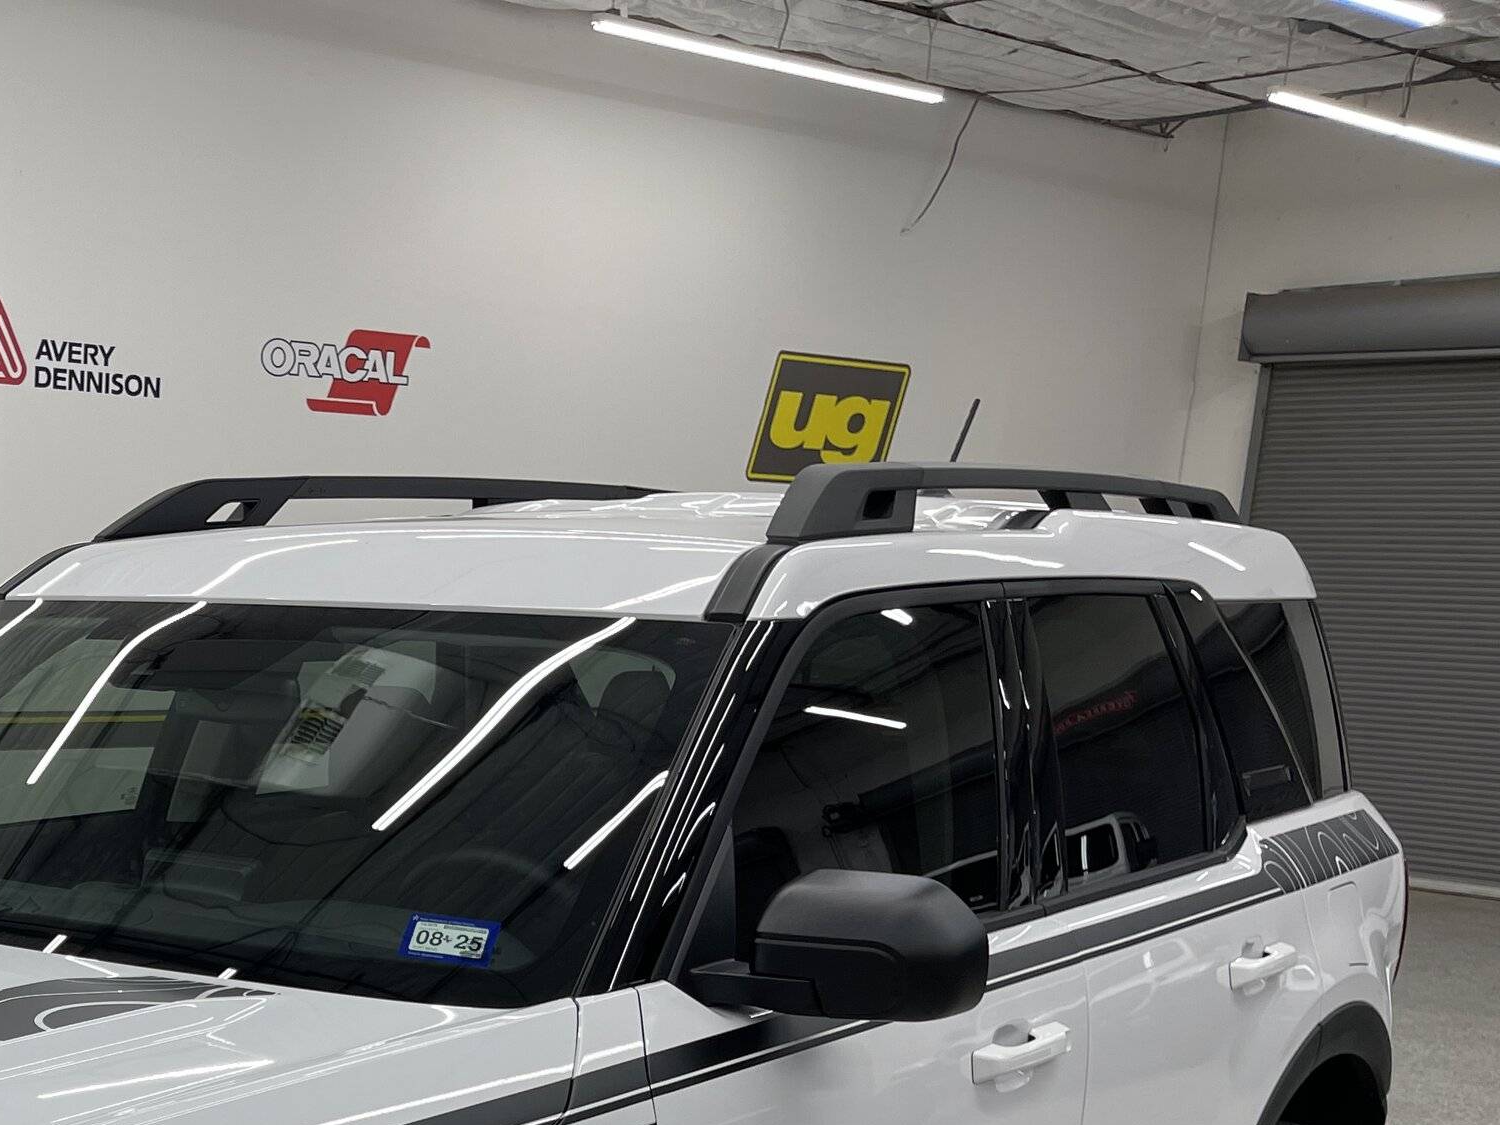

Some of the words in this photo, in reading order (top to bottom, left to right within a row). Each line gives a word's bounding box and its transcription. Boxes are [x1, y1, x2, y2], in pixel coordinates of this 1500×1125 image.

[34, 338, 115, 368] AVERY
[260, 337, 409, 387] ORACAL
[33, 365, 161, 399] DENNISON
[769, 390, 891, 463] ug
[415, 929, 443, 947] 08
[453, 934, 484, 952] 25
